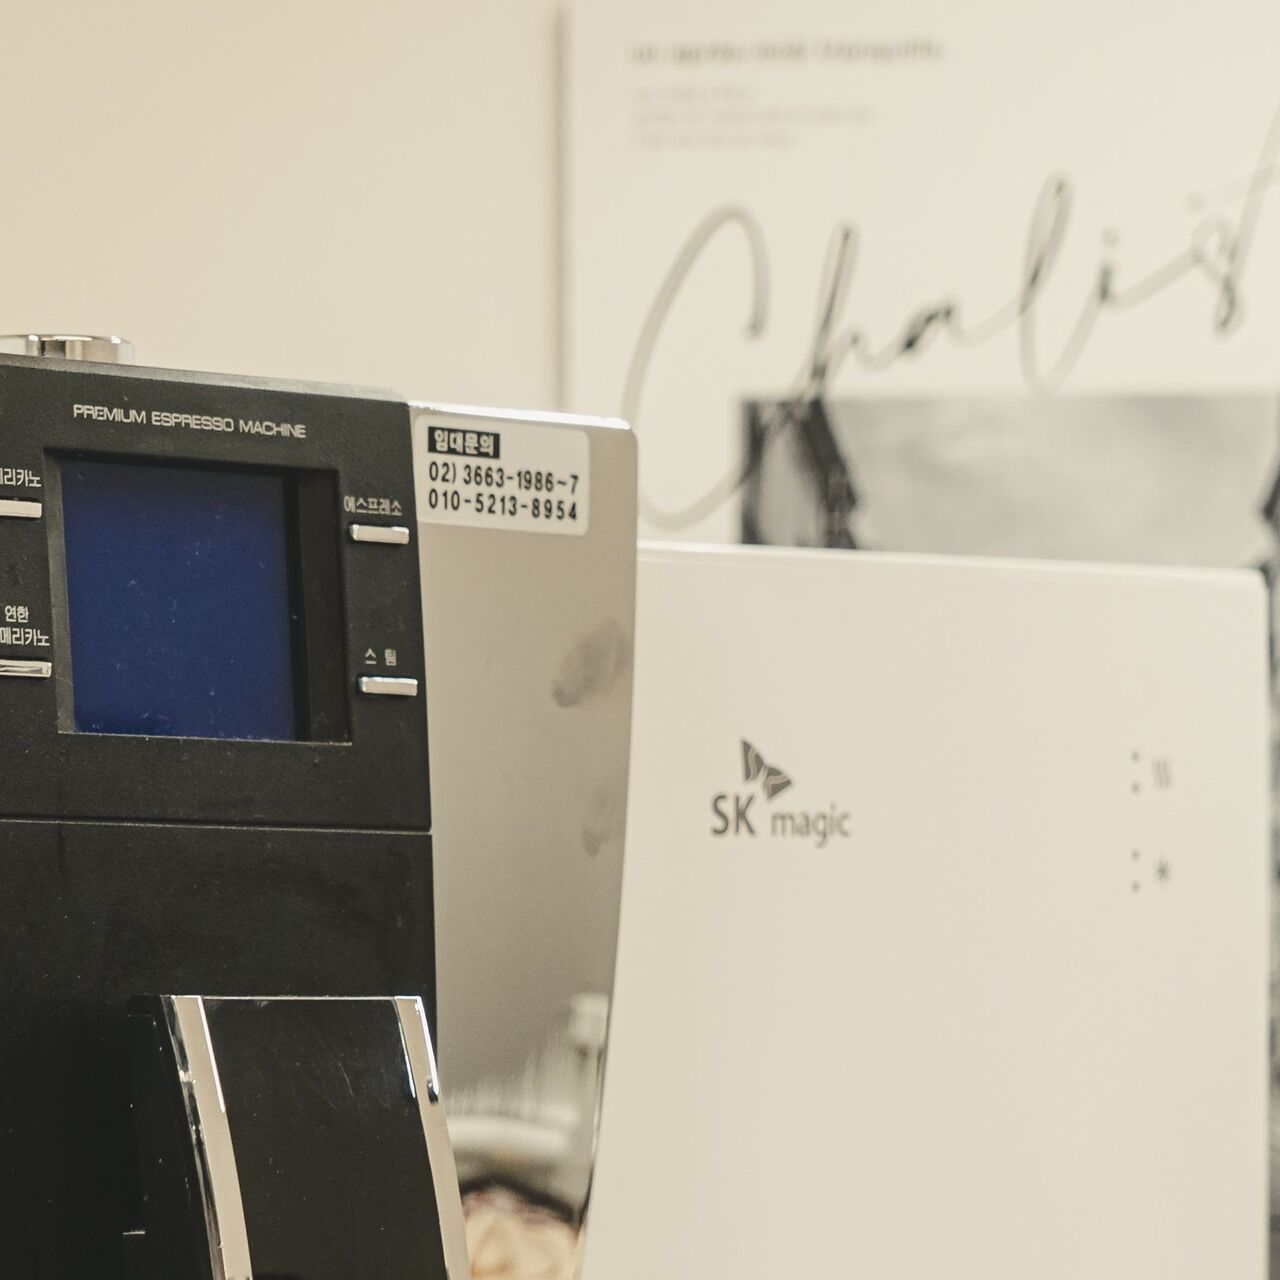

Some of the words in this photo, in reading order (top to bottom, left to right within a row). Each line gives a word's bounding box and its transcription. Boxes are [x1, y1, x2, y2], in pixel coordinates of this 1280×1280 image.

[73, 404, 147, 425] PREMIUM
[151, 411, 234, 433] ESPRESSO
[239, 419, 307, 439] MACHINE
[433, 429, 495, 457] 임대문의
[343, 495, 403, 517] 에스프레소
[428, 488, 578, 521] 010-5213-8954
[4, 605, 29, 623] 연한
[712, 794, 756, 836] SK
[770, 801, 850, 849] magic
